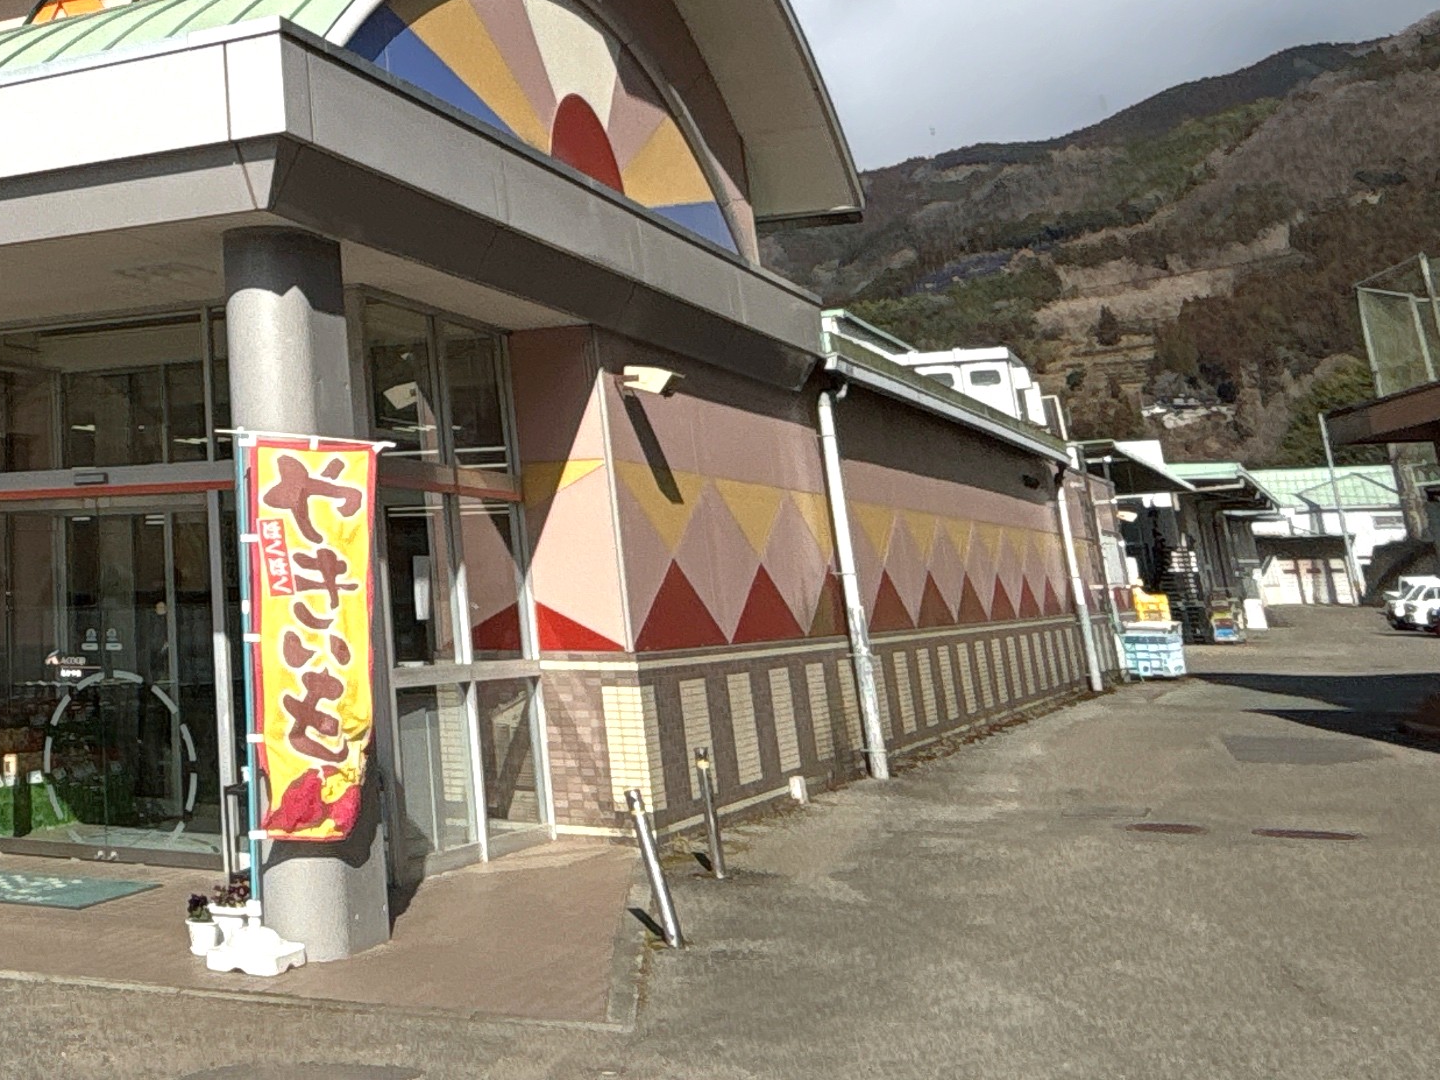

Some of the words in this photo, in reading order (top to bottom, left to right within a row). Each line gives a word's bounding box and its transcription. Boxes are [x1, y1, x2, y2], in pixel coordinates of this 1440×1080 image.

[262, 520, 293, 594] ほくほく
[262, 454, 363, 763] やきいも
